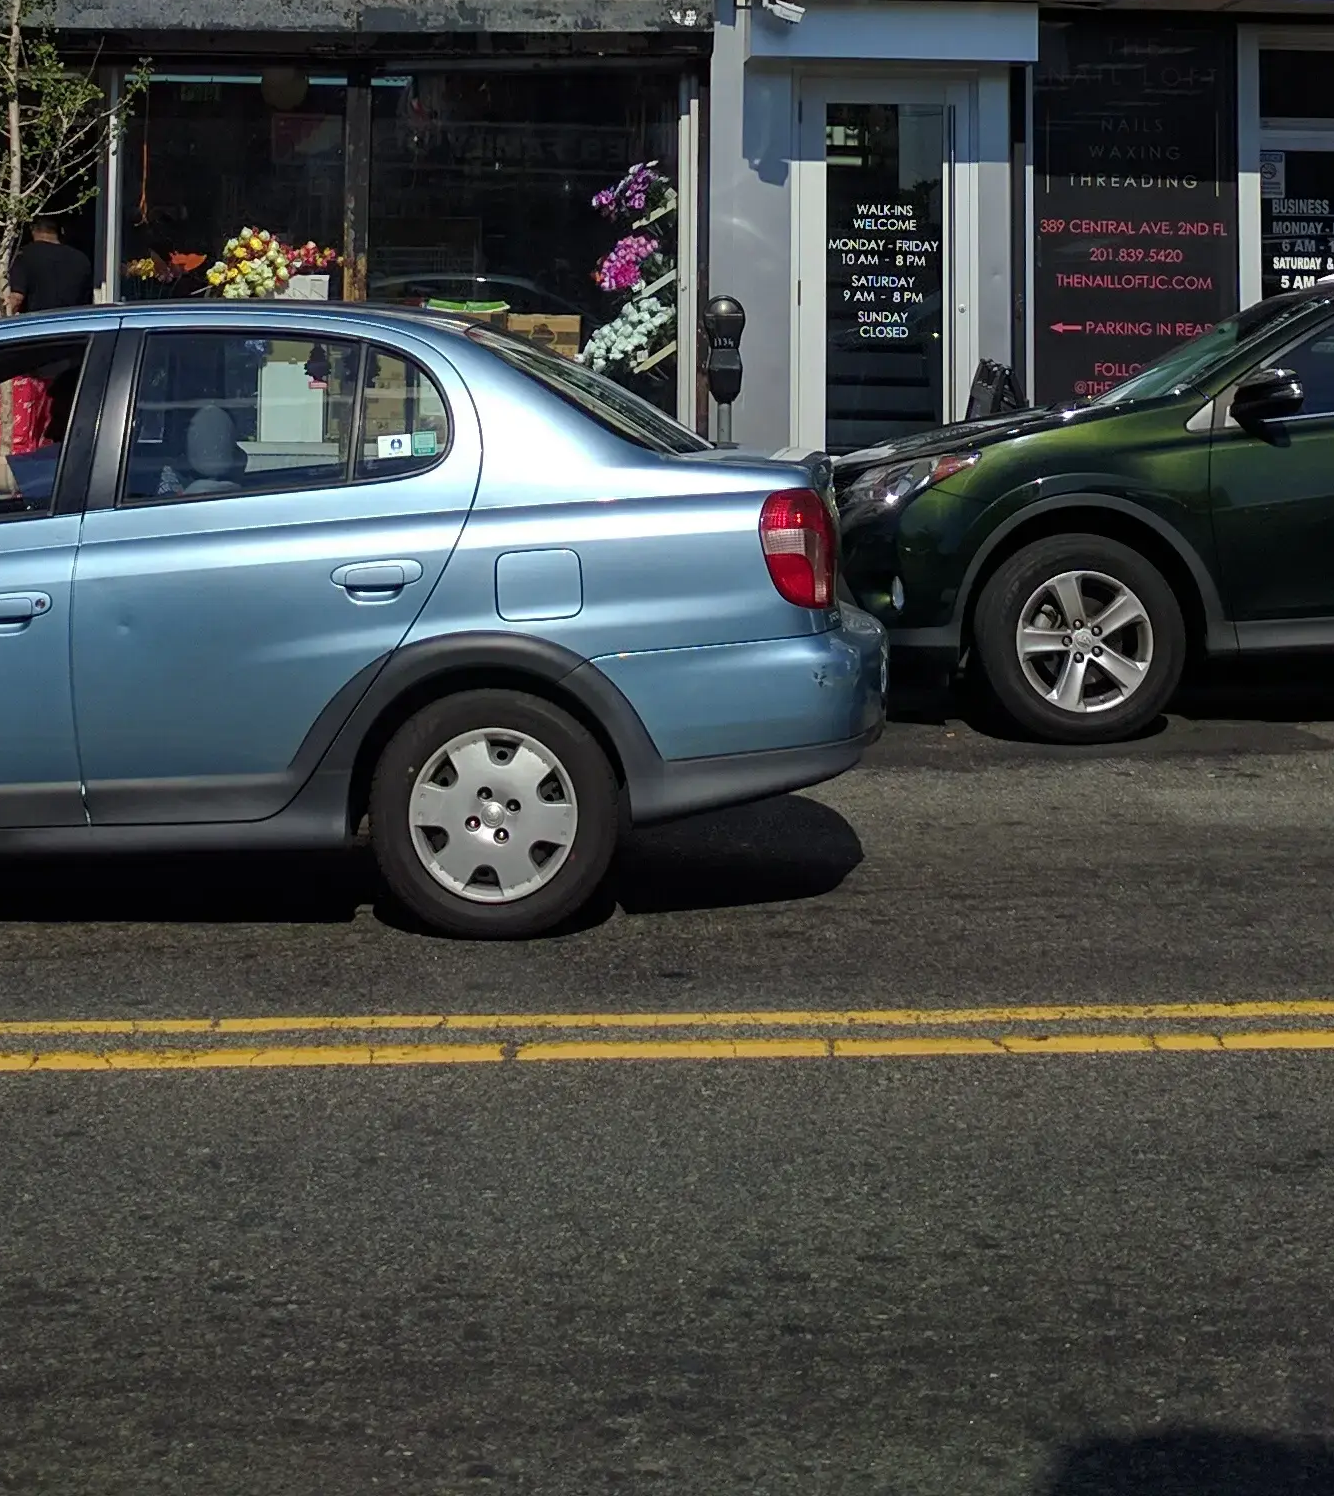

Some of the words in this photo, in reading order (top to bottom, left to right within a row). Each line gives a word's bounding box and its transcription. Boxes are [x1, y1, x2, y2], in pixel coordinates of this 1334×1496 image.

[1100, 117, 1164, 134] NAILS
[1088, 143, 1182, 161] WAXING
[1069, 173, 1199, 189] THREADING
[856, 204, 913, 216] WALK-INS
[1271, 199, 1329, 215] BUSINESS
[853, 218, 917, 231] WELCOME
[1040, 219, 1066, 234] 389
[1069, 220, 1136, 235] CENTRAL
[1178, 222, 1209, 236] 2ND
[1213, 222, 1228, 236] FL
[1272, 221, 1324, 235] MONDAY
[828, 238, 886, 251] MONDAY
[895, 240, 939, 252] FRIDAY
[1281, 240, 1291, 252] 6
[1294, 240, 1316, 253] AM
[842, 253, 855, 265] 10
[857, 254, 879, 265] AM
[895, 255, 904, 266] 8
[906, 255, 926, 266] PM
[1089, 247, 1183, 263] 201.839.5420
[1272, 257, 1322, 270] SATURDAY
[1326, 257, 1334, 270] &
[851, 275, 916, 288] SATURDAY
[1056, 273, 1213, 290] THENAILLOFTJC.COM
[1280, 275, 1290, 289] 5
[1293, 275, 1316, 290] AM
[843, 289, 851, 302] 9
[853, 291, 875, 302] AM
[892, 291, 901, 303] 8
[903, 292, 924, 303] PM
[857, 310, 909, 323] SUNDAY
[859, 326, 909, 338] CLOSED
[1085, 321, 1153, 336] PARKING
[1156, 323, 1172, 336] IN
